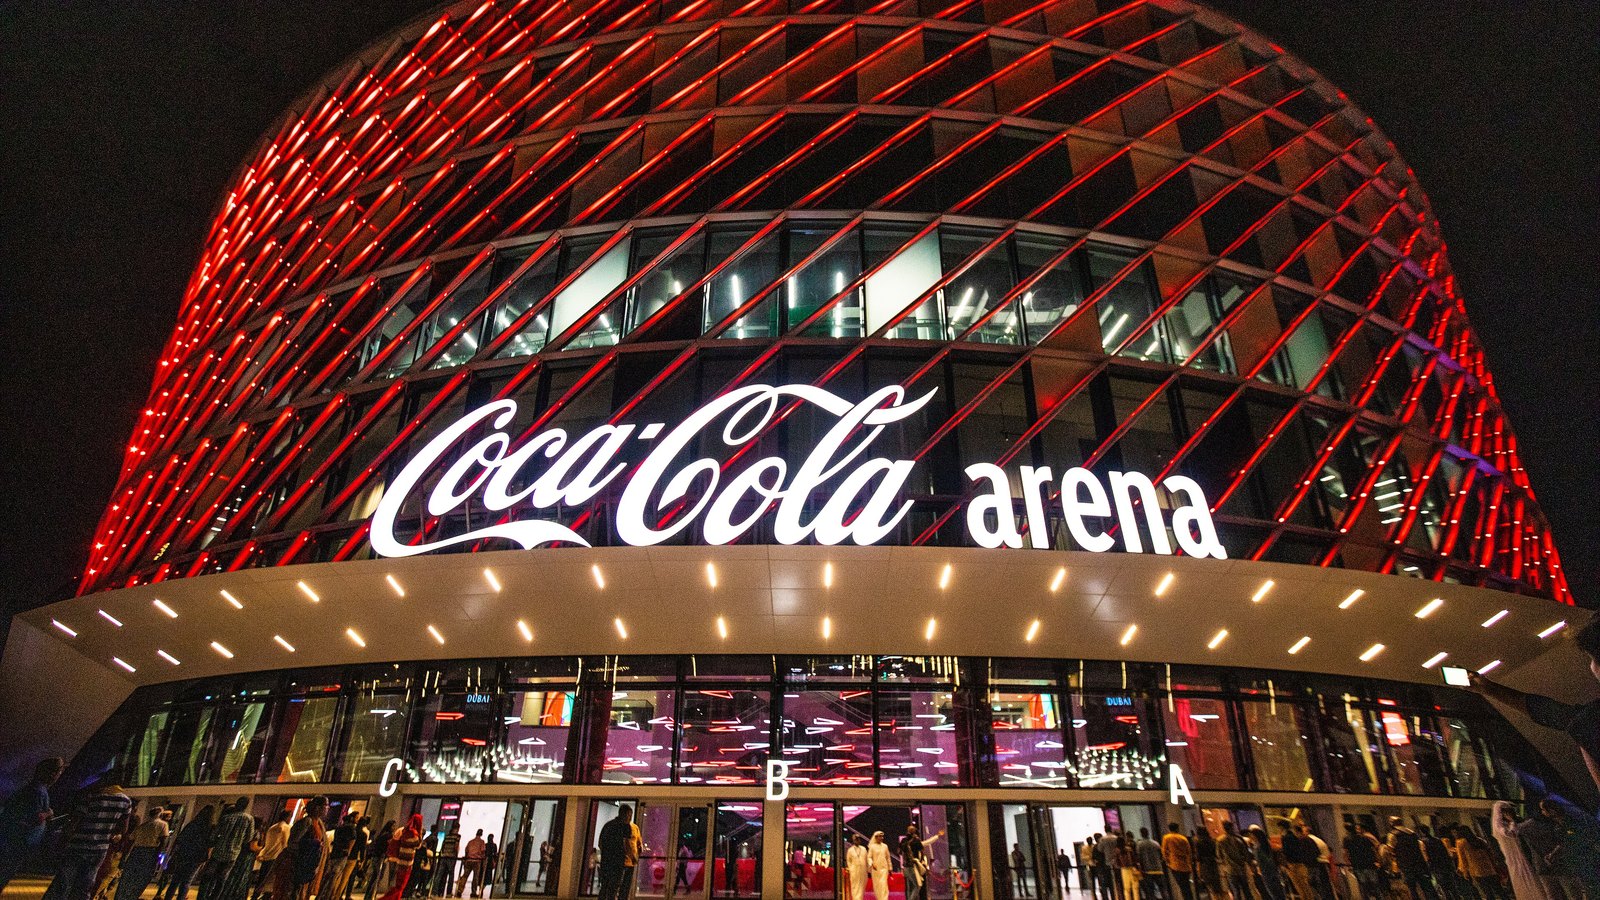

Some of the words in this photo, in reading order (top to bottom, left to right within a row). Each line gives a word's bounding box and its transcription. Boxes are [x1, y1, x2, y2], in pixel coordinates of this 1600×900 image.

[369, 384, 938, 558] Coca-Cola
[965, 462, 1228, 560] arena
[466, 694, 490, 703] DUBAI
[1105, 697, 1132, 706] DUBAI
[379, 757, 403, 797] C
[766, 759, 790, 801] B
[1169, 763, 1195, 805] A
